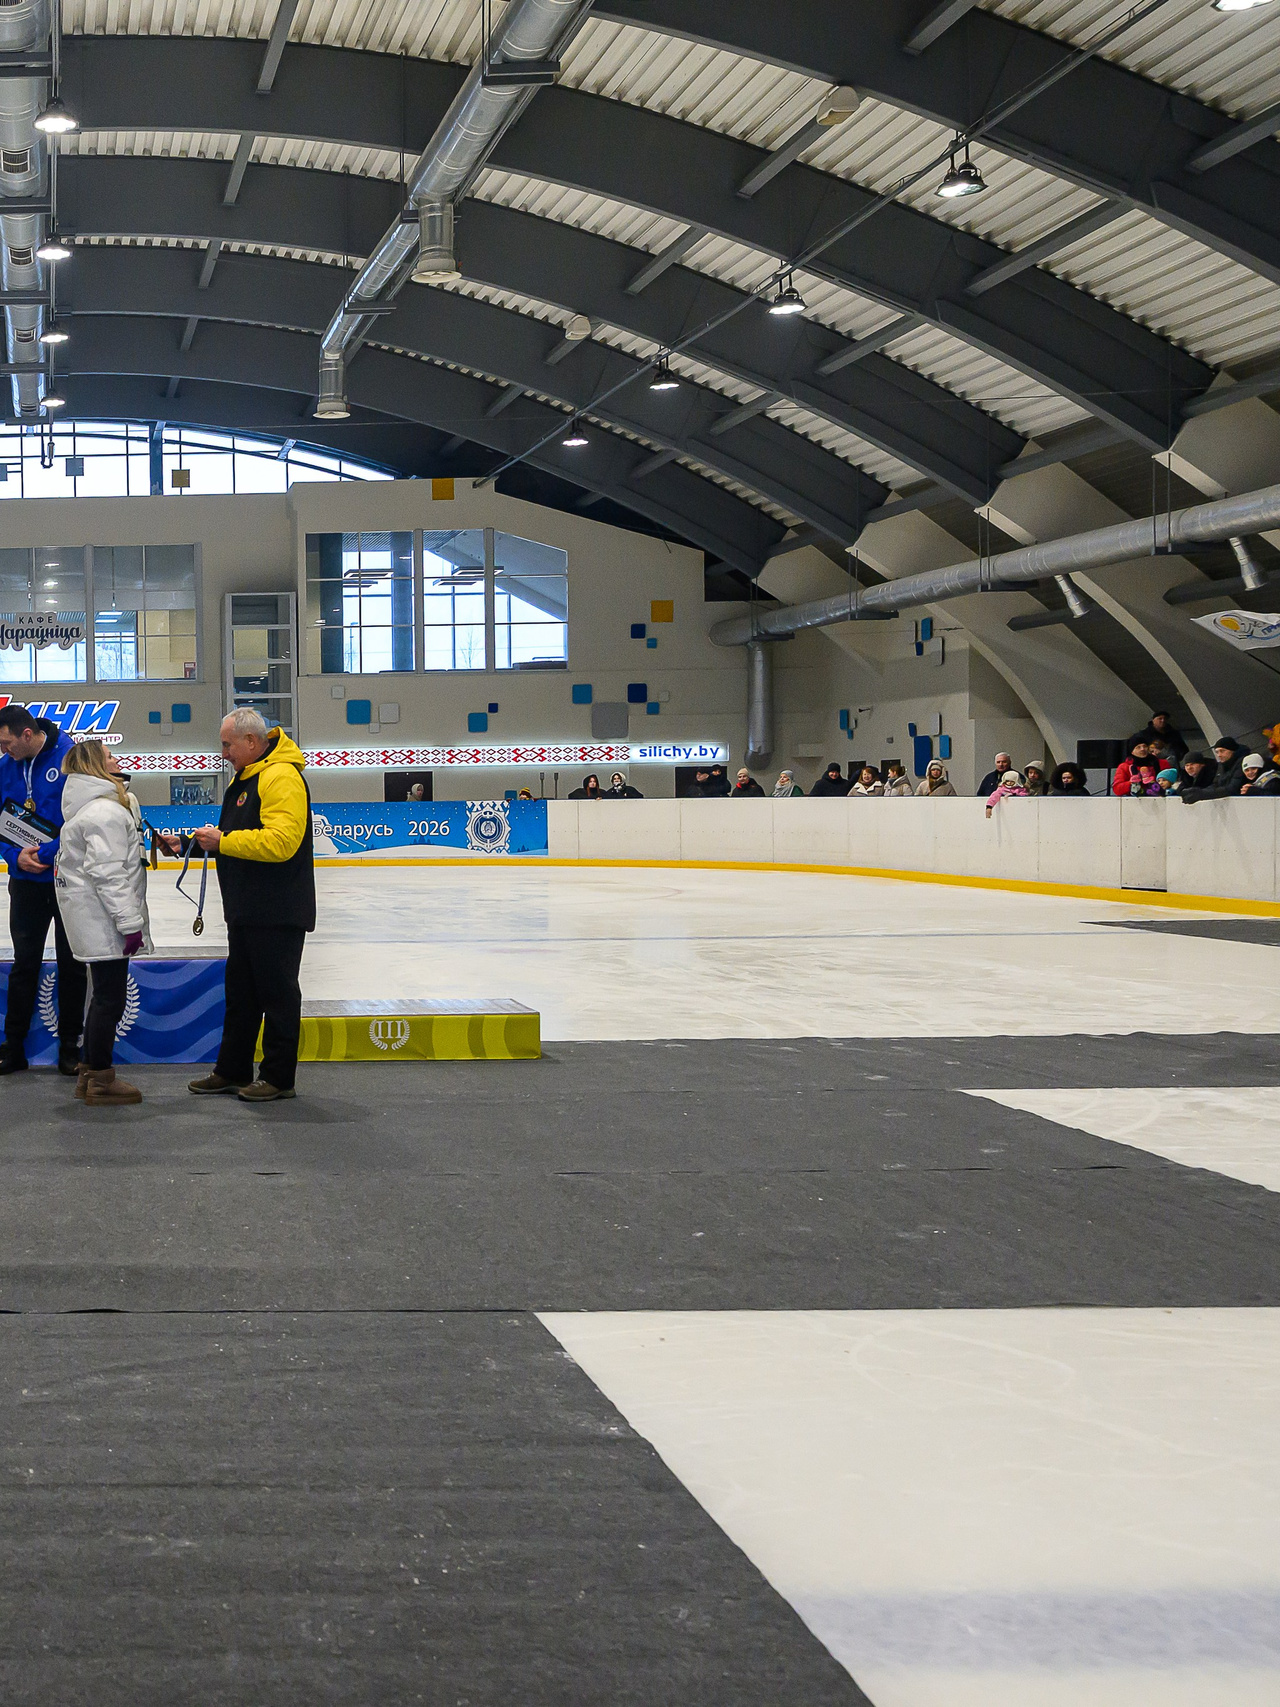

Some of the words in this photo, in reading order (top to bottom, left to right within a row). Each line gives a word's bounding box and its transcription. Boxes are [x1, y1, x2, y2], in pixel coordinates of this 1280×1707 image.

[18, 616, 53, 625] КАФЕ
[638, 745, 720, 759] silichy.by
[312, 820, 394, 840] Беларусь
[407, 820, 450, 837] 2026
[376, 1020, 404, 1039] III
